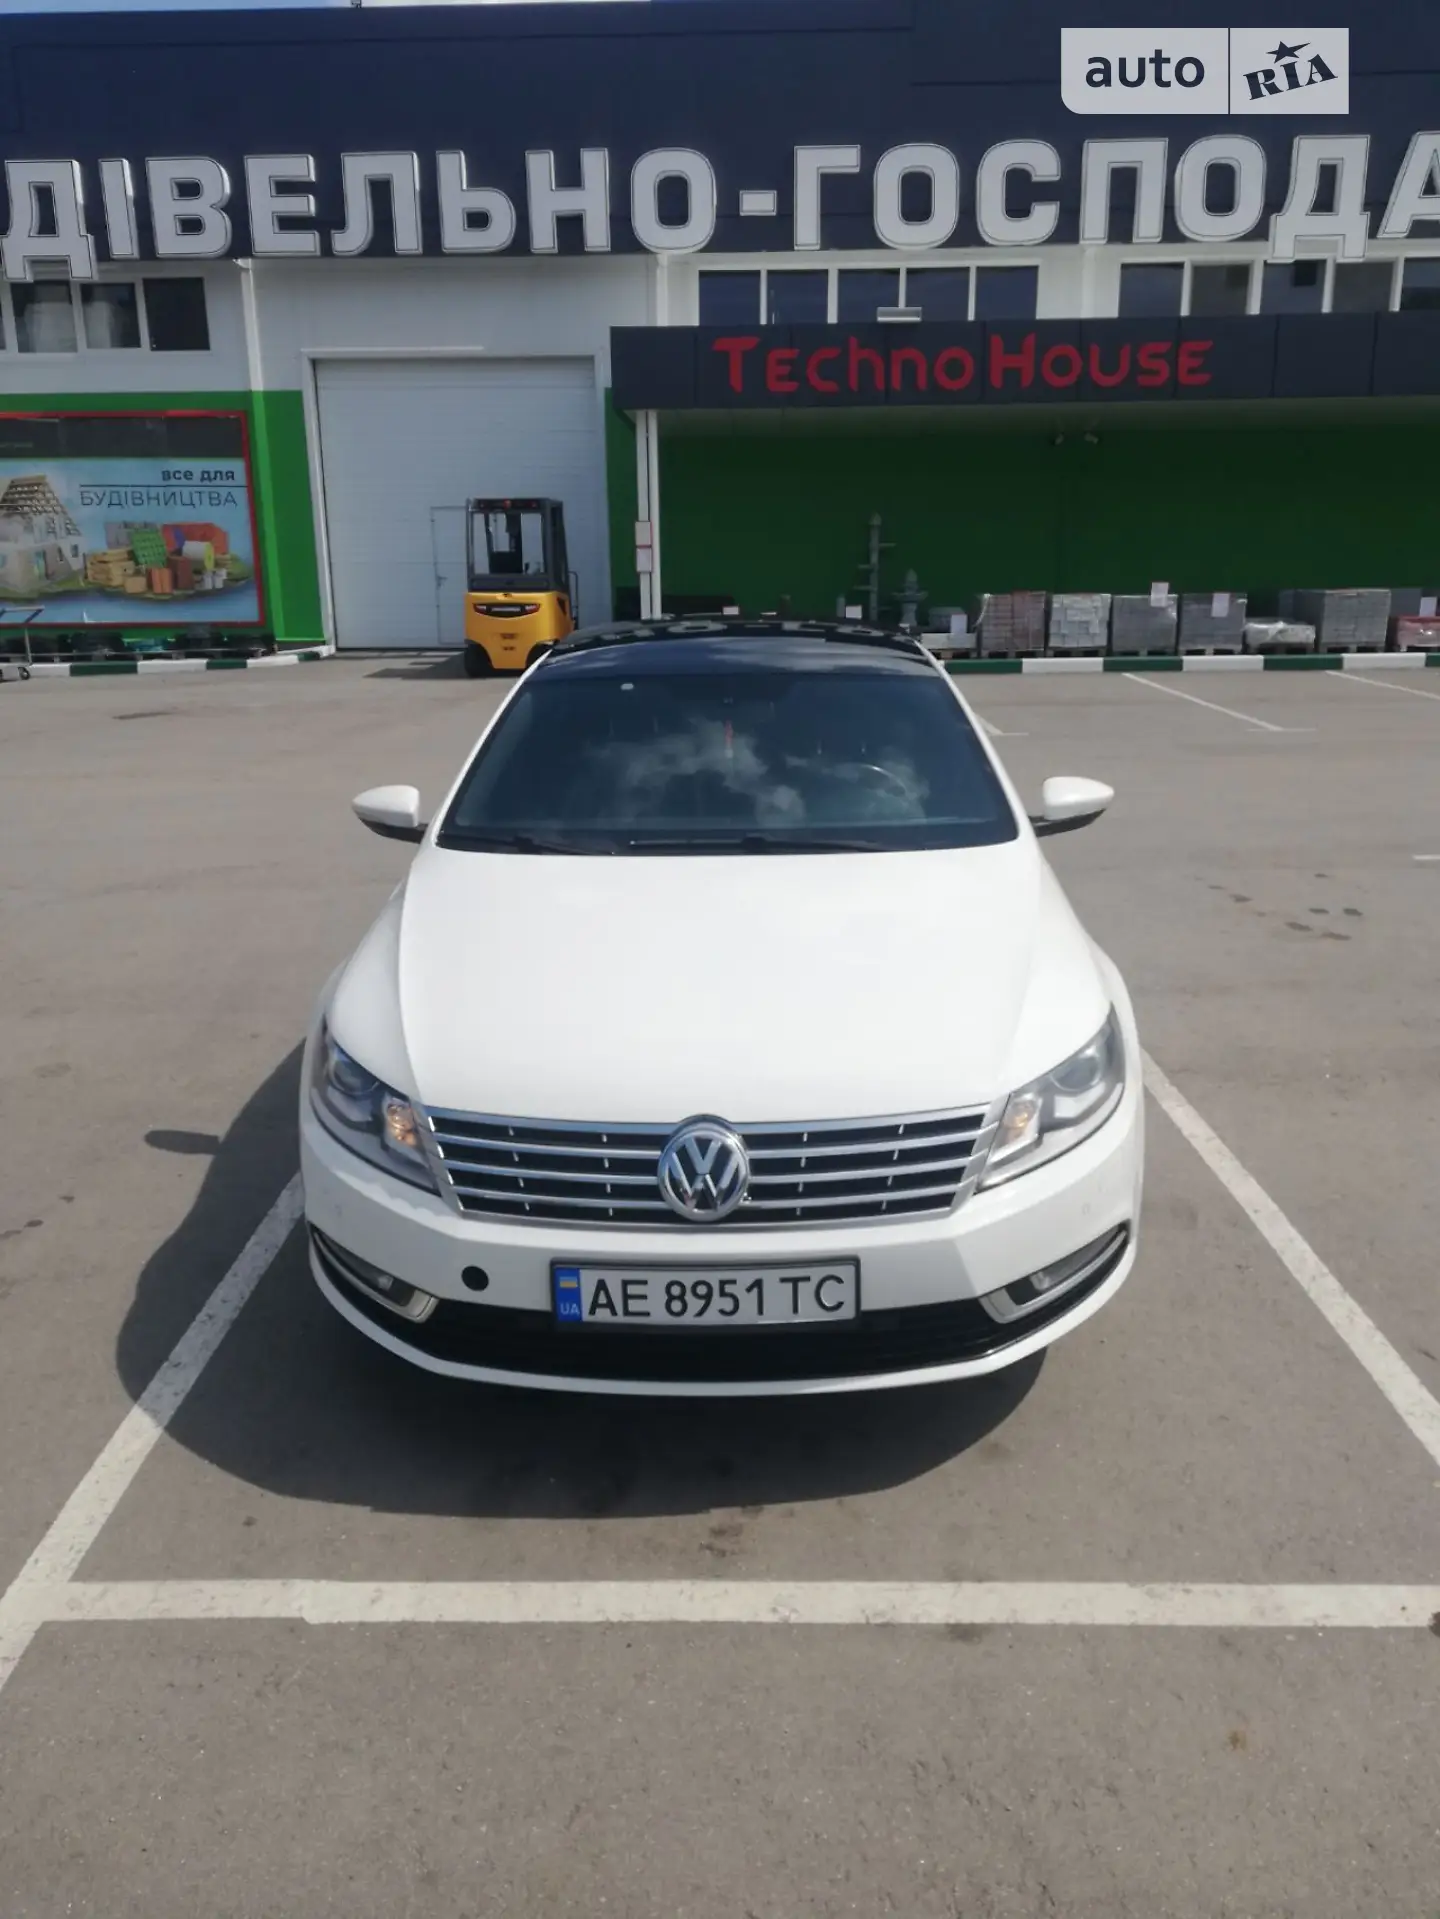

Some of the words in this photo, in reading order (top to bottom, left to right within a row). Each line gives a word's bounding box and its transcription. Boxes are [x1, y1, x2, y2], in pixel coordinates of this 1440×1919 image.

[162, 468, 194, 482] все
[200, 469, 235, 483] для
[80, 490, 238, 508] БУДІВНИЦТВА
[588, 1278, 650, 1318] AE
[664, 1278, 765, 1318] 8951
[779, 1274, 845, 1315] TC
[560, 1302, 580, 1316] UA
